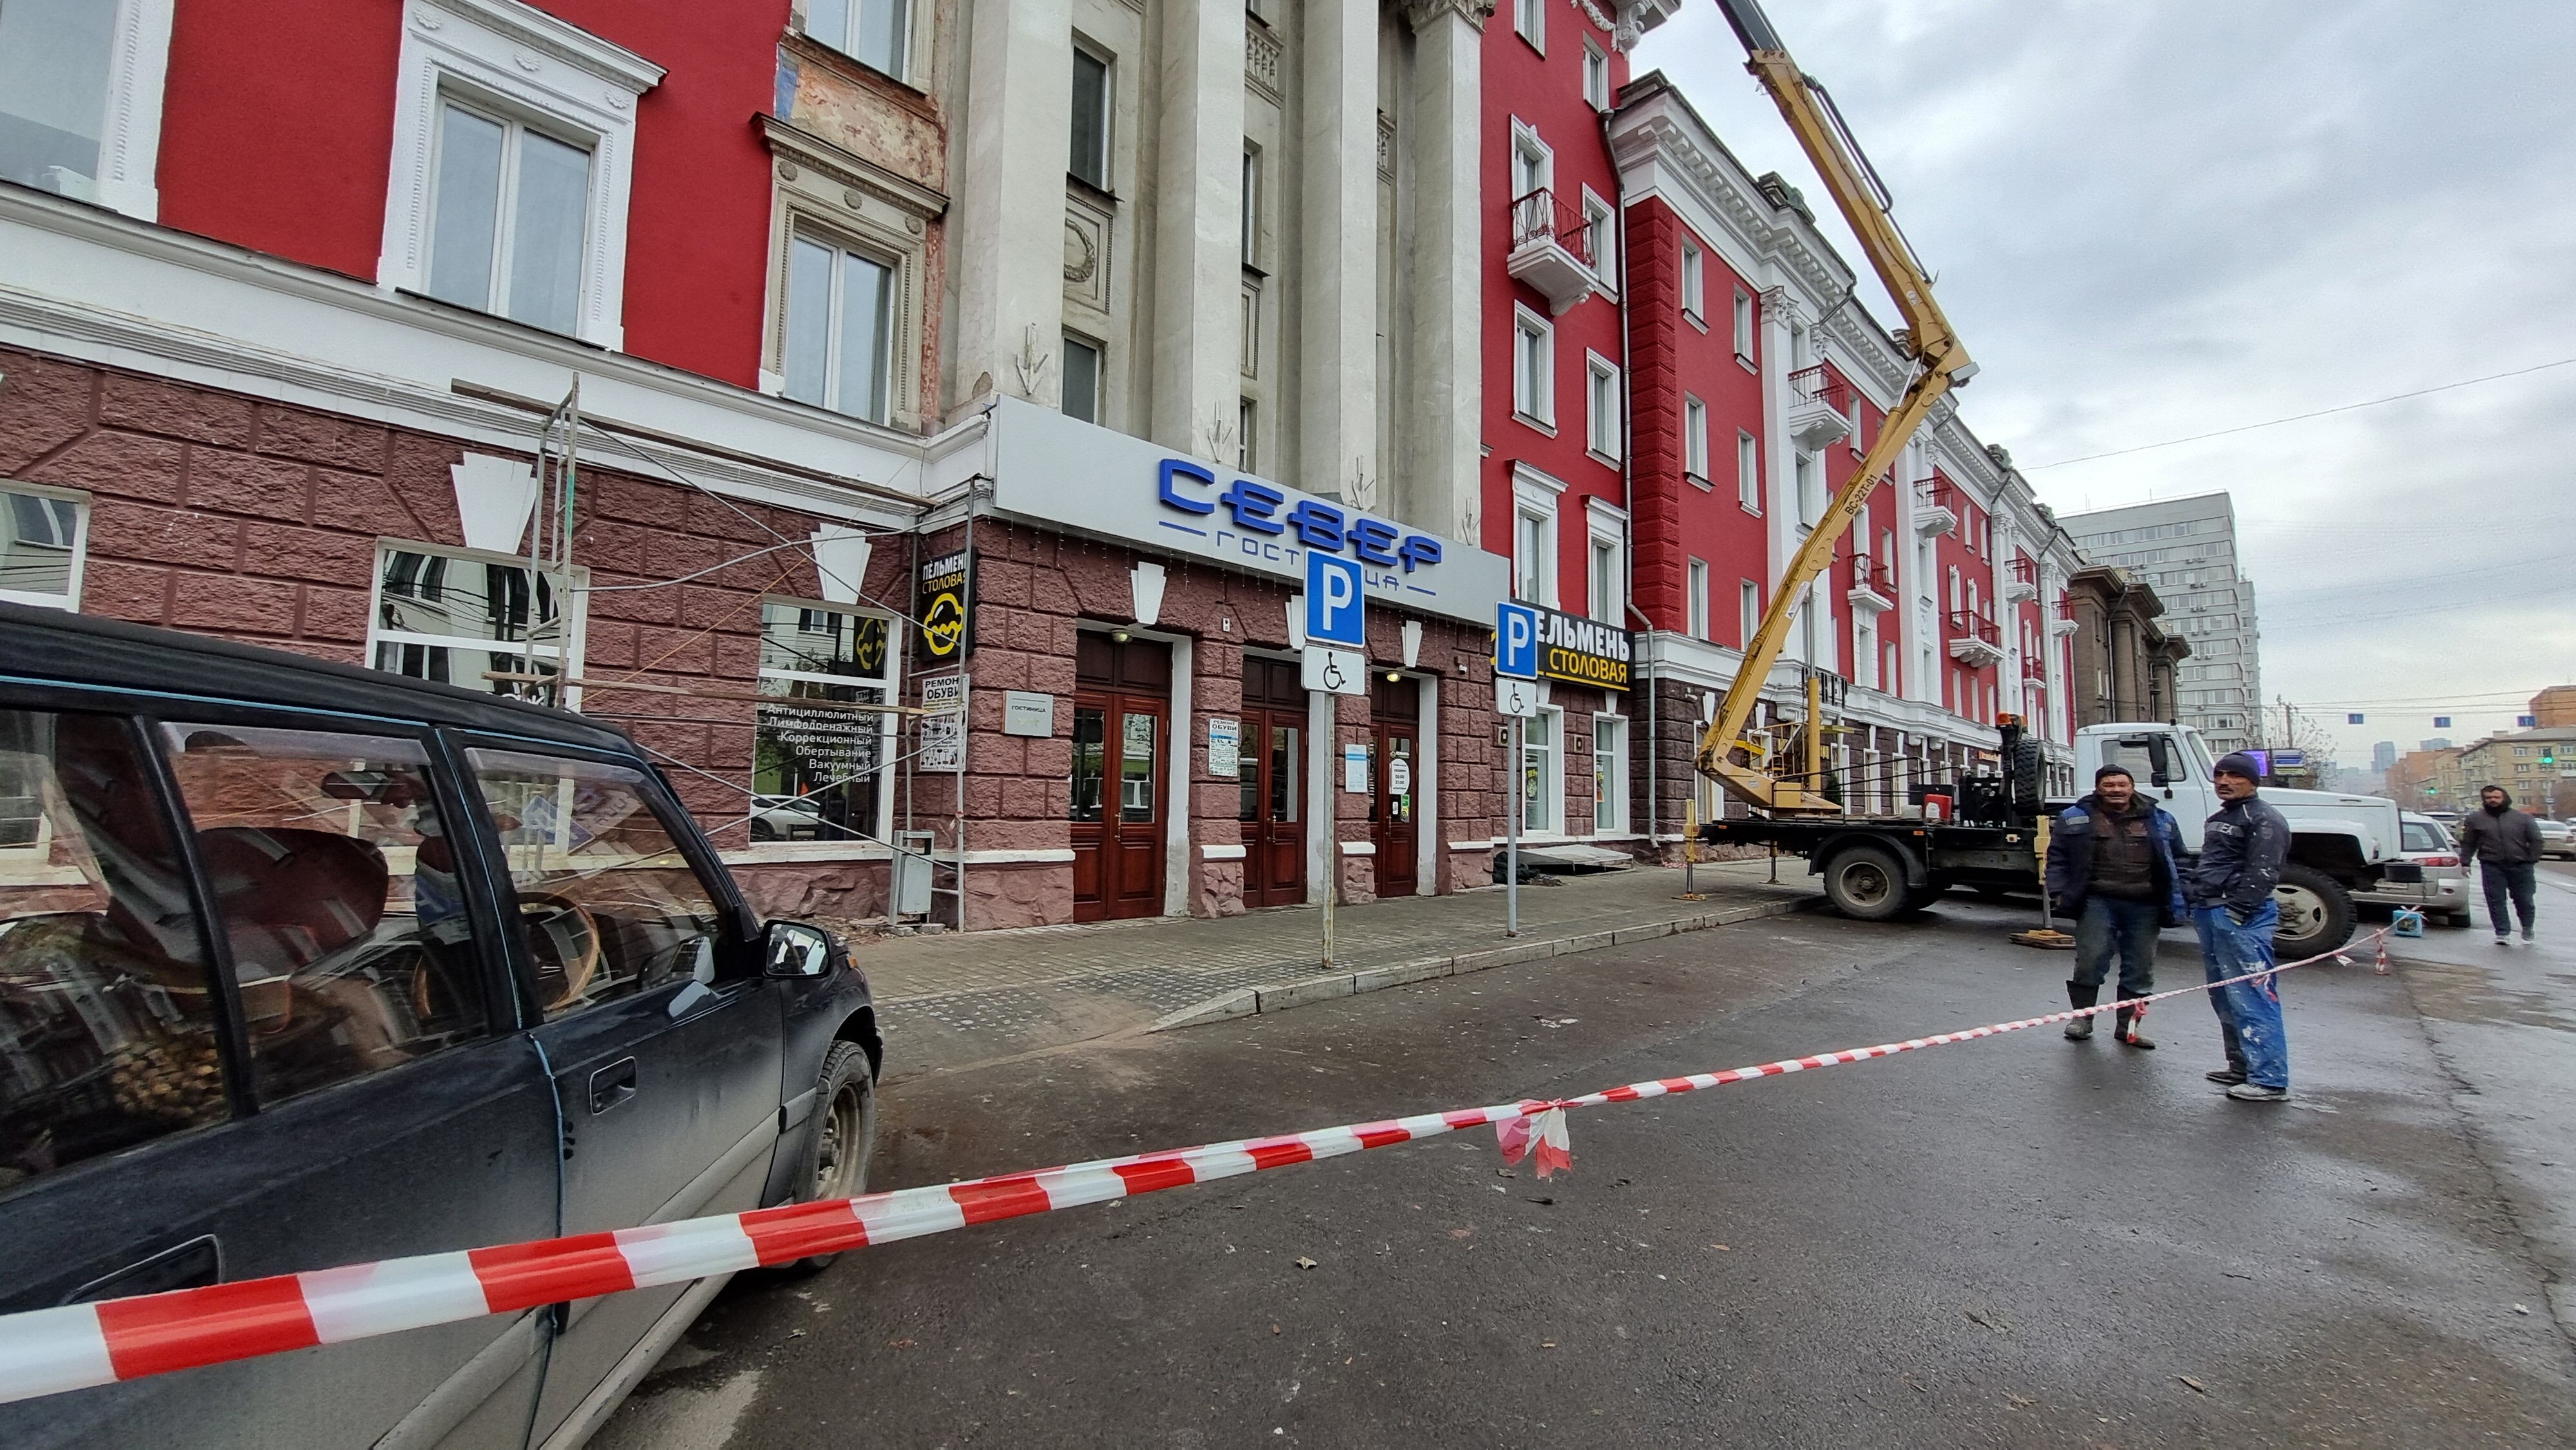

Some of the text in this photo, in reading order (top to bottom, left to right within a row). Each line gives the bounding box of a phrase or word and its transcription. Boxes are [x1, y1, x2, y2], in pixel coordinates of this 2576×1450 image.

[1160, 458, 1442, 573] СЕВЕР
[1217, 531, 1399, 591] ГОСТЦА
[1322, 563, 1352, 631] P
[1508, 612, 1530, 666] P
[1535, 610, 1630, 661] ЕЛЬМЕНЬ
[925, 677, 960, 688] РЕМОН
[1549, 648, 1627, 684] СТОЛОВАЯ
[781, 731, 872, 745] Коррекционный
[795, 746, 871, 758] Обертывание
[809, 758, 871, 771] Вакуумный
